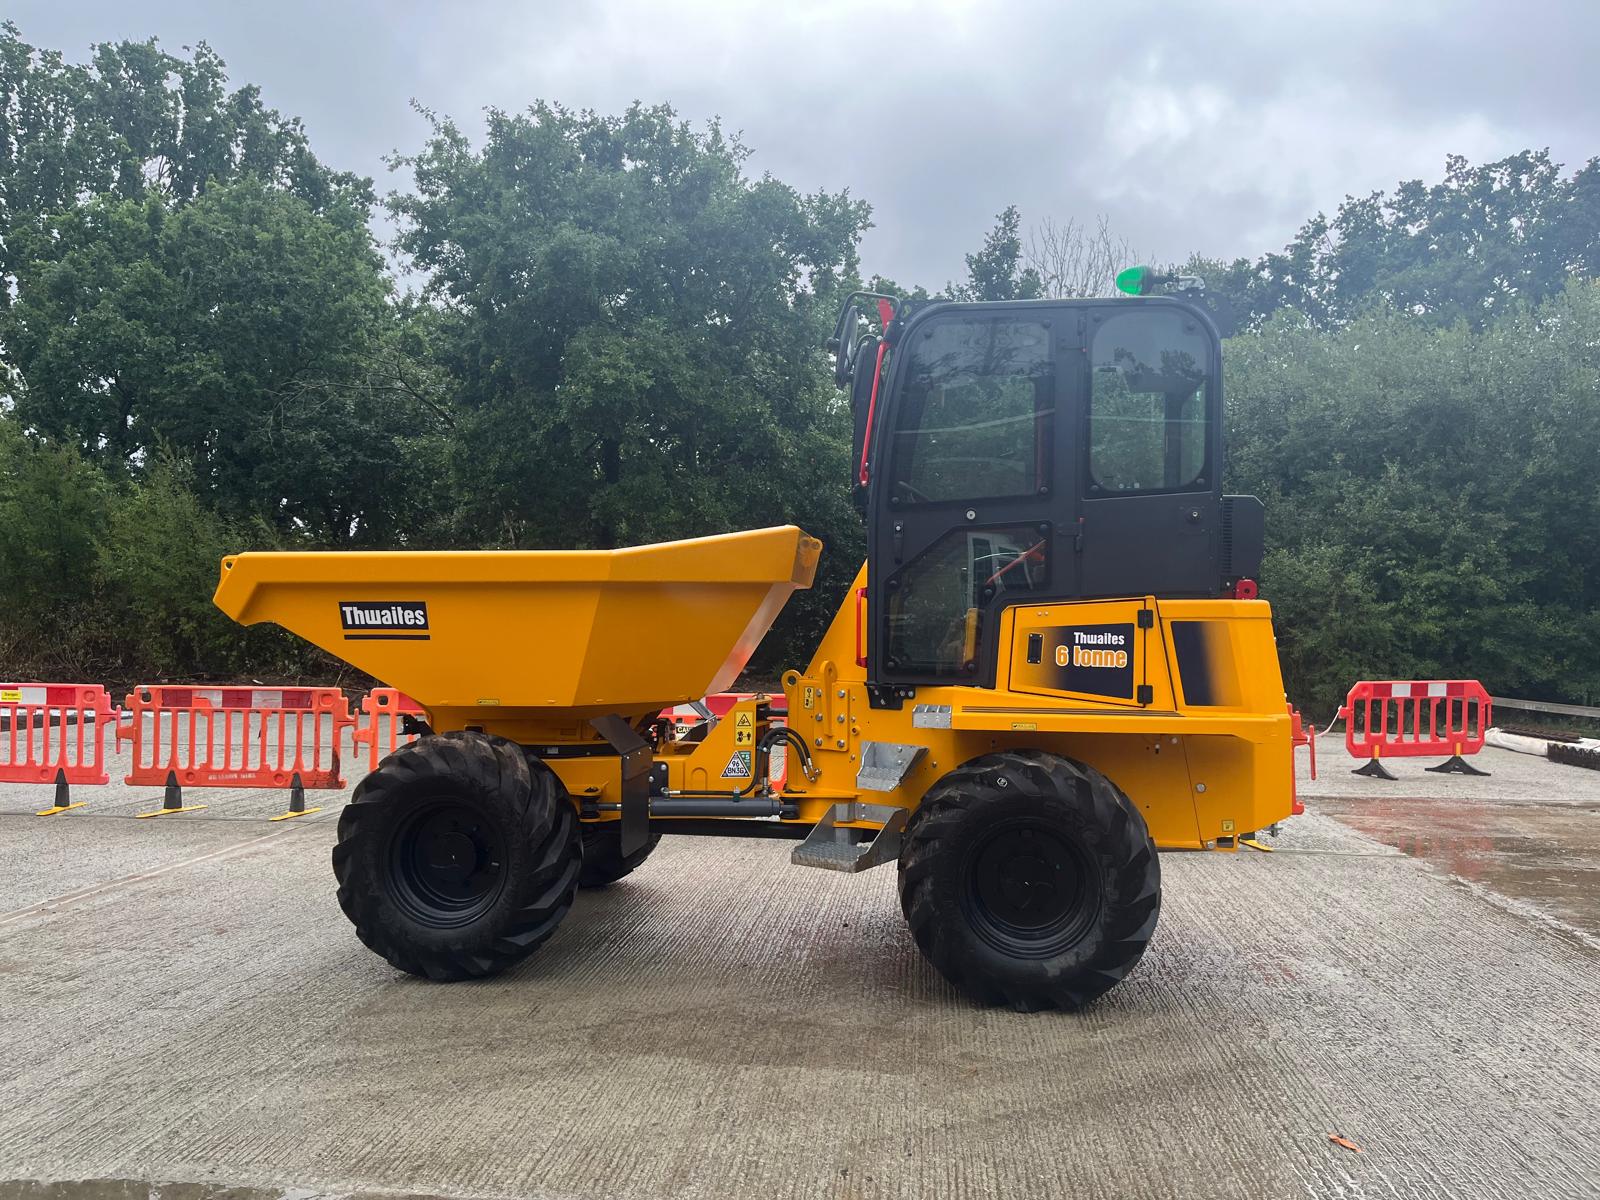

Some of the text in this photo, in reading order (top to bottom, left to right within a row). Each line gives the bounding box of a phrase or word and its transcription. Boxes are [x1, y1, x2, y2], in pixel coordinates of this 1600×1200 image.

[342, 606, 425, 625] Thwaites
[1073, 632, 1125, 645] Thwaites
[1055, 645, 1128, 668] 6 tonne
